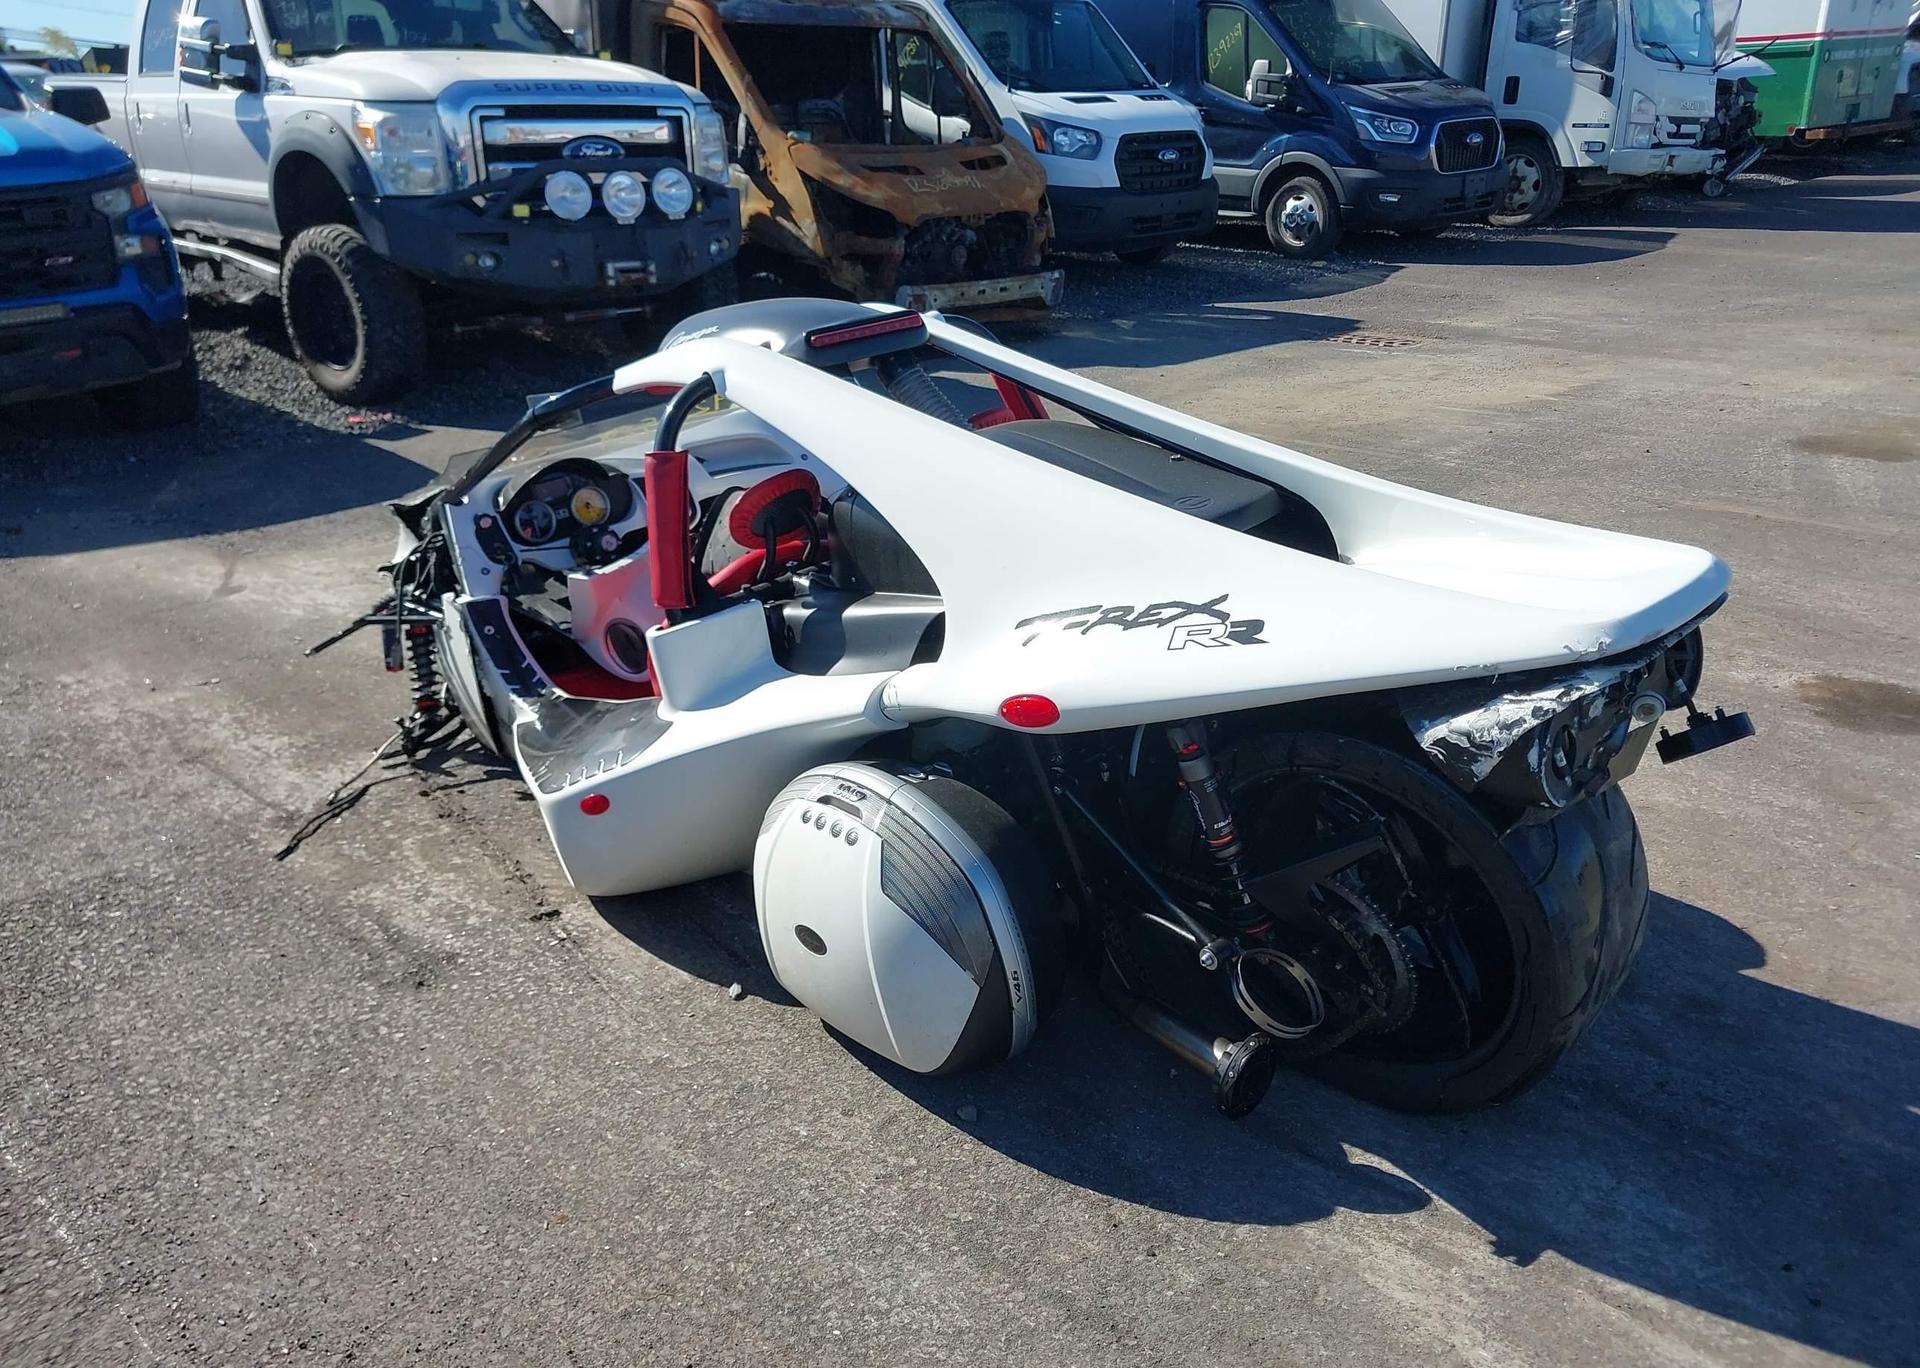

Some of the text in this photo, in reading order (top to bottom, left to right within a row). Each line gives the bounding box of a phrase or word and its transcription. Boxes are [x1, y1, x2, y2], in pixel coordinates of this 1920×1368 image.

[493, 82, 657, 96] SUPER DUTY
[579, 142, 613, 157] Ford
[1014, 593, 1231, 647] T-REX
[1167, 618, 1271, 651] RR
